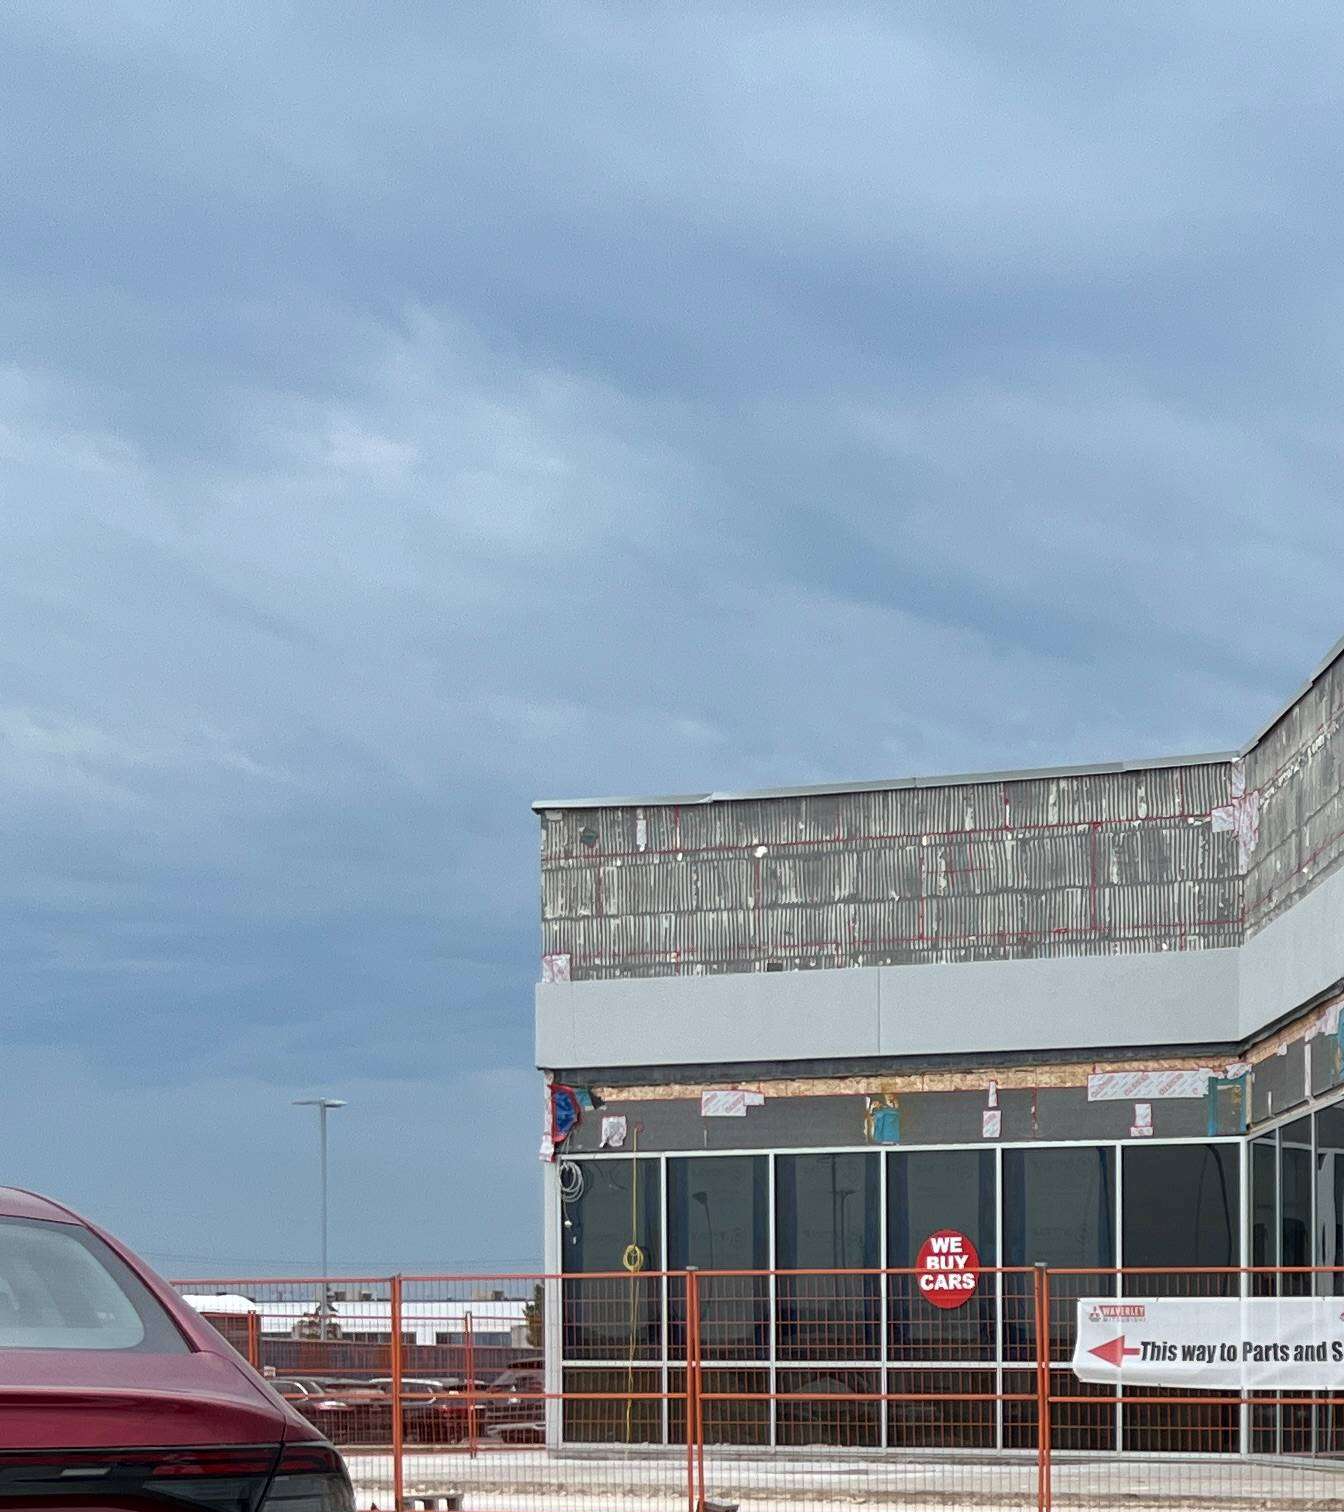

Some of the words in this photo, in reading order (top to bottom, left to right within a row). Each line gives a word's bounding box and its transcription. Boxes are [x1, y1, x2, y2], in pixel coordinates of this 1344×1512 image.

[930, 1236, 963, 1253] WE
[926, 1254, 969, 1270] BUY
[920, 1273, 975, 1291] CARS
[1140, 1341, 1178, 1362] This
[1181, 1344, 1216, 1363] way
[1220, 1342, 1238, 1362] to
[1242, 1341, 1290, 1362] Parts
[1293, 1341, 1327, 1362] and
